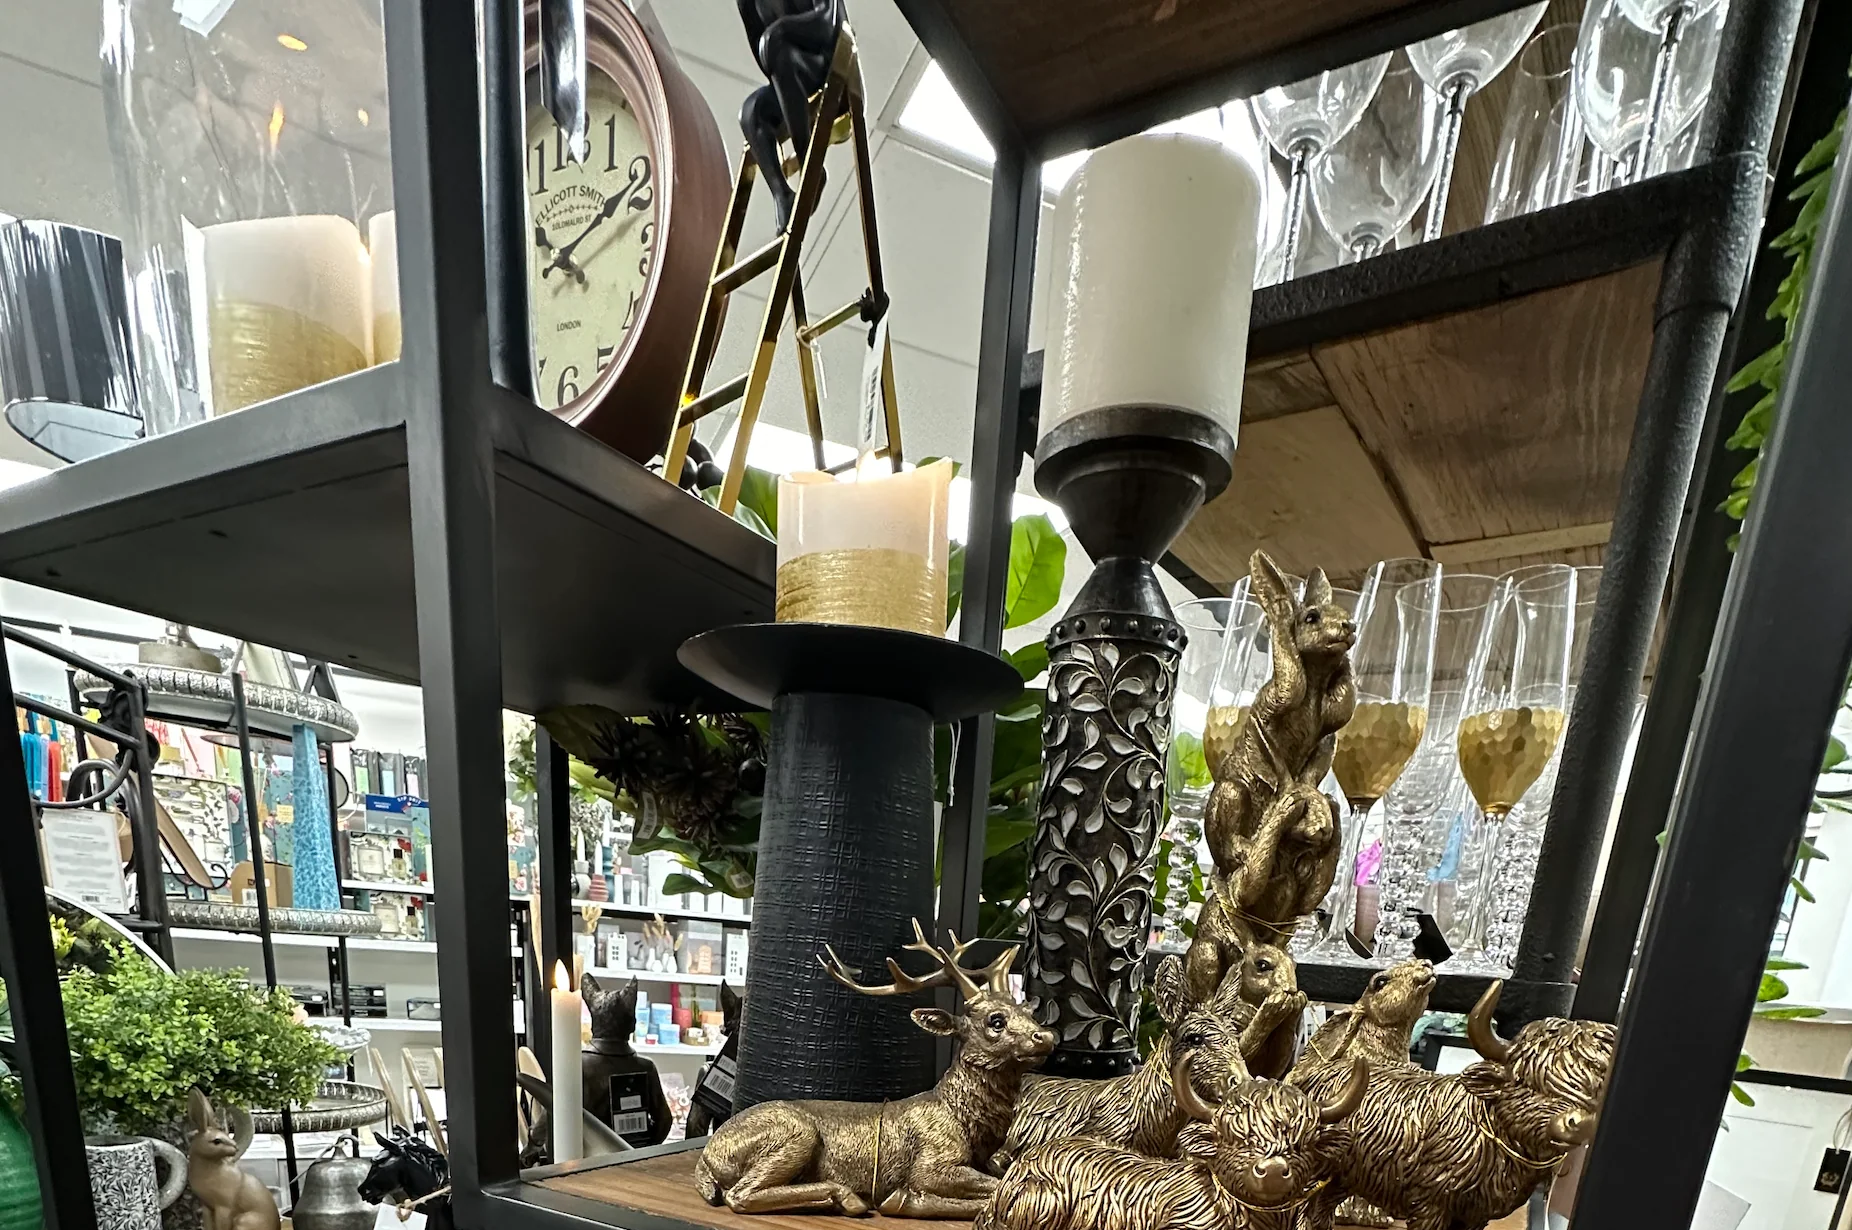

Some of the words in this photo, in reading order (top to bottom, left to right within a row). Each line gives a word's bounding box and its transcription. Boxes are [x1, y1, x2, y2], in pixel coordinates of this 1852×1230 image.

[603, 113, 618, 173] 1
[535, 185, 578, 228] ELLICOTT
[628, 154, 654, 216] 2
[556, 320, 581, 332] LONDON
[557, 365, 579, 408] 6
